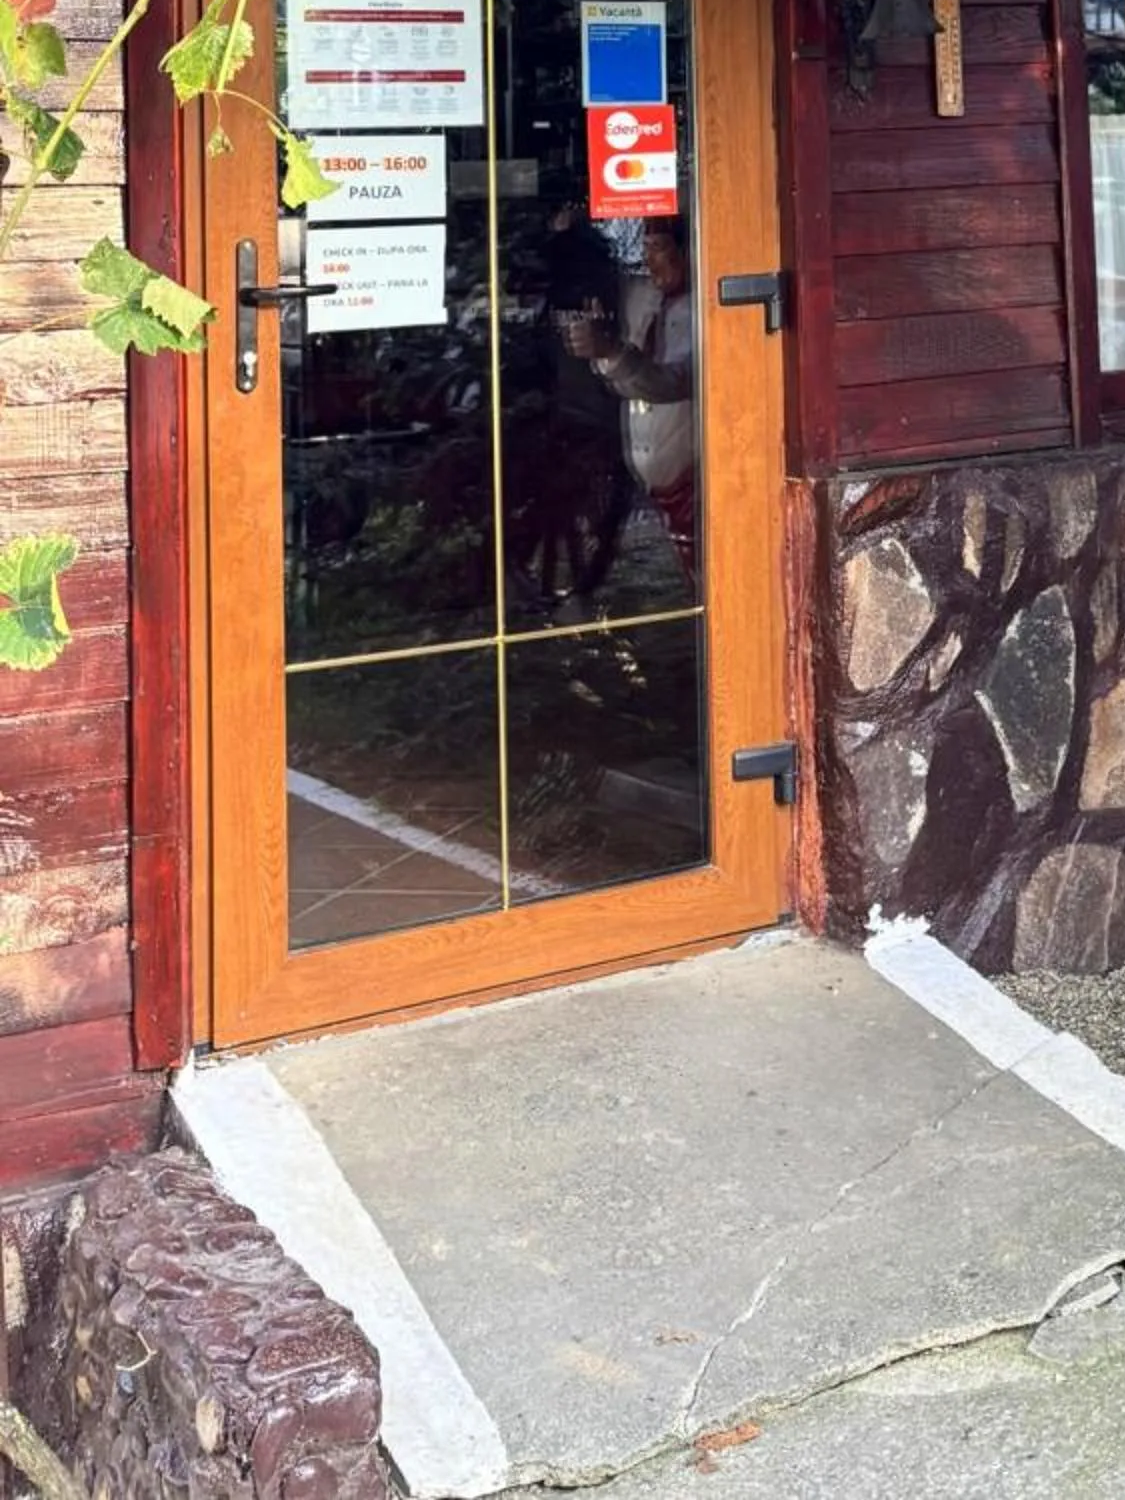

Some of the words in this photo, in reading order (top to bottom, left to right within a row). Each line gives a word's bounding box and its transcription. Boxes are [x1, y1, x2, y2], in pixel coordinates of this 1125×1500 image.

[607, 120, 663, 136] Edenred
[323, 156, 367, 172] 13:00
[383, 156, 427, 171] 16:00
[349, 185, 402, 199] PAUZA
